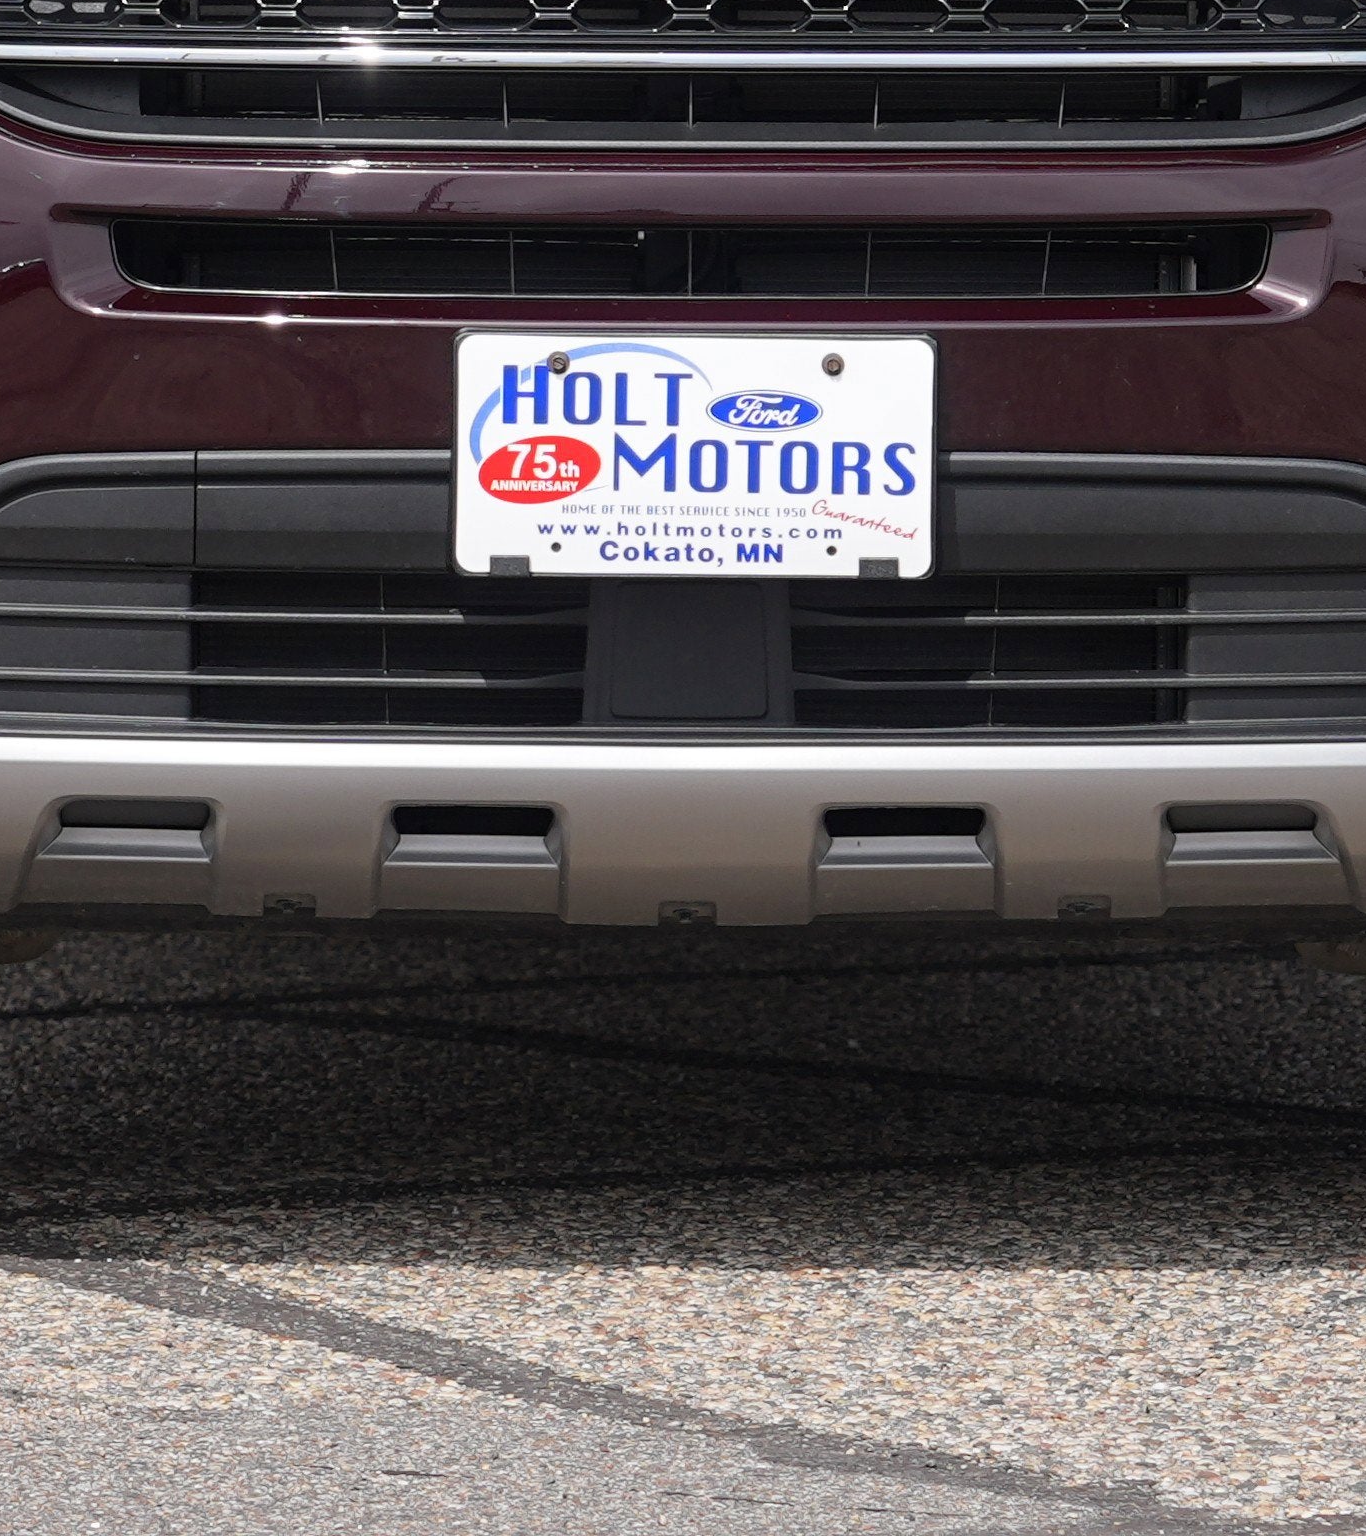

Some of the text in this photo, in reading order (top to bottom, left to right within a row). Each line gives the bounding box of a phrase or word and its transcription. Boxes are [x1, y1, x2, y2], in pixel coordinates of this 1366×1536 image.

[502, 364, 693, 427] HOLT
[728, 394, 802, 426] Ford
[506, 443, 581, 480] 75th
[613, 431, 917, 496] MOTORS
[490, 479, 580, 493] ANNIVERSARY
[561, 504, 807, 518] HOME OF THE BEST SERVICE SINCE 1950
[811, 499, 919, 541] Guaranteed
[537, 521, 843, 540] www.holtmotors.com
[599, 540, 784, 567] Cokato, MN
